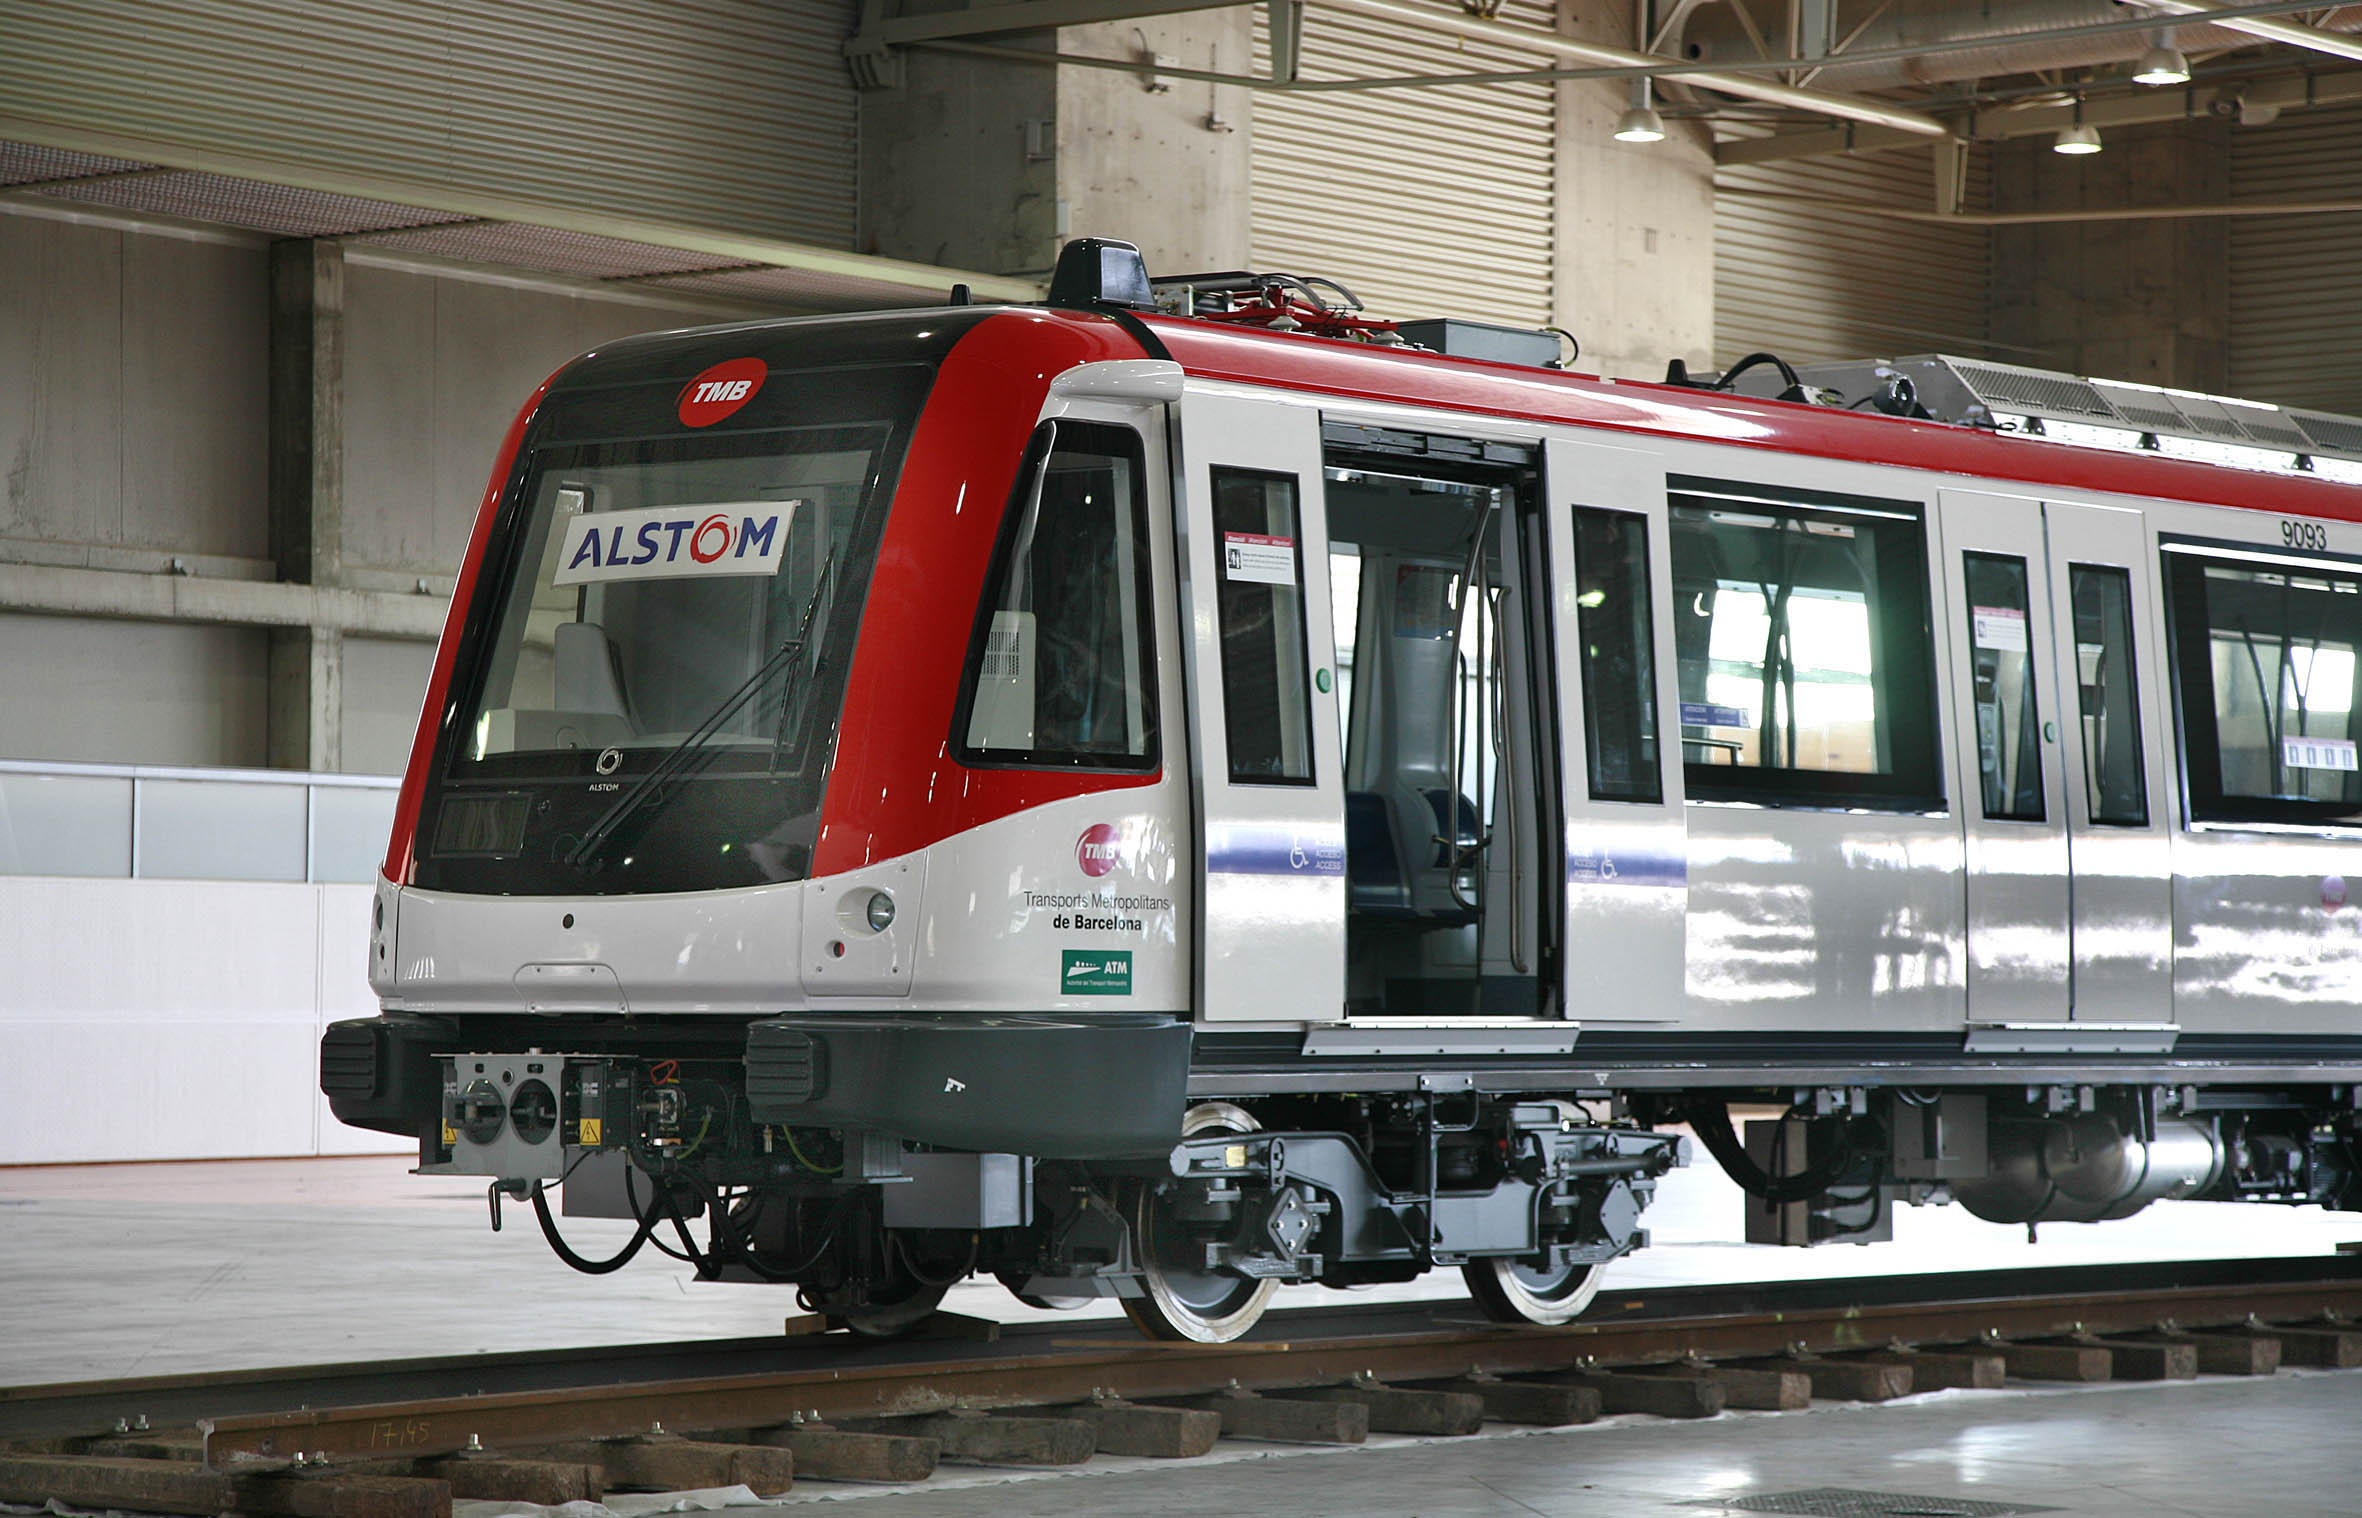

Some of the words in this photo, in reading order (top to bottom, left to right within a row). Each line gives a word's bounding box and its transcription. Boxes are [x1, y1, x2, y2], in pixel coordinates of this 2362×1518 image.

[693, 380, 752, 404] TMB
[568, 514, 779, 570] ALSTOM
[2281, 520, 2327, 550] 9093
[588, 783, 620, 792] ALSTOM
[1084, 843, 1116, 860] TMB
[1024, 891, 1088, 911] Transports
[1091, 893, 1169, 913] Metropolitans
[1053, 914, 1070, 929] de
[1075, 914, 1142, 931] Barcelona
[1104, 960, 1128, 975] ATM
